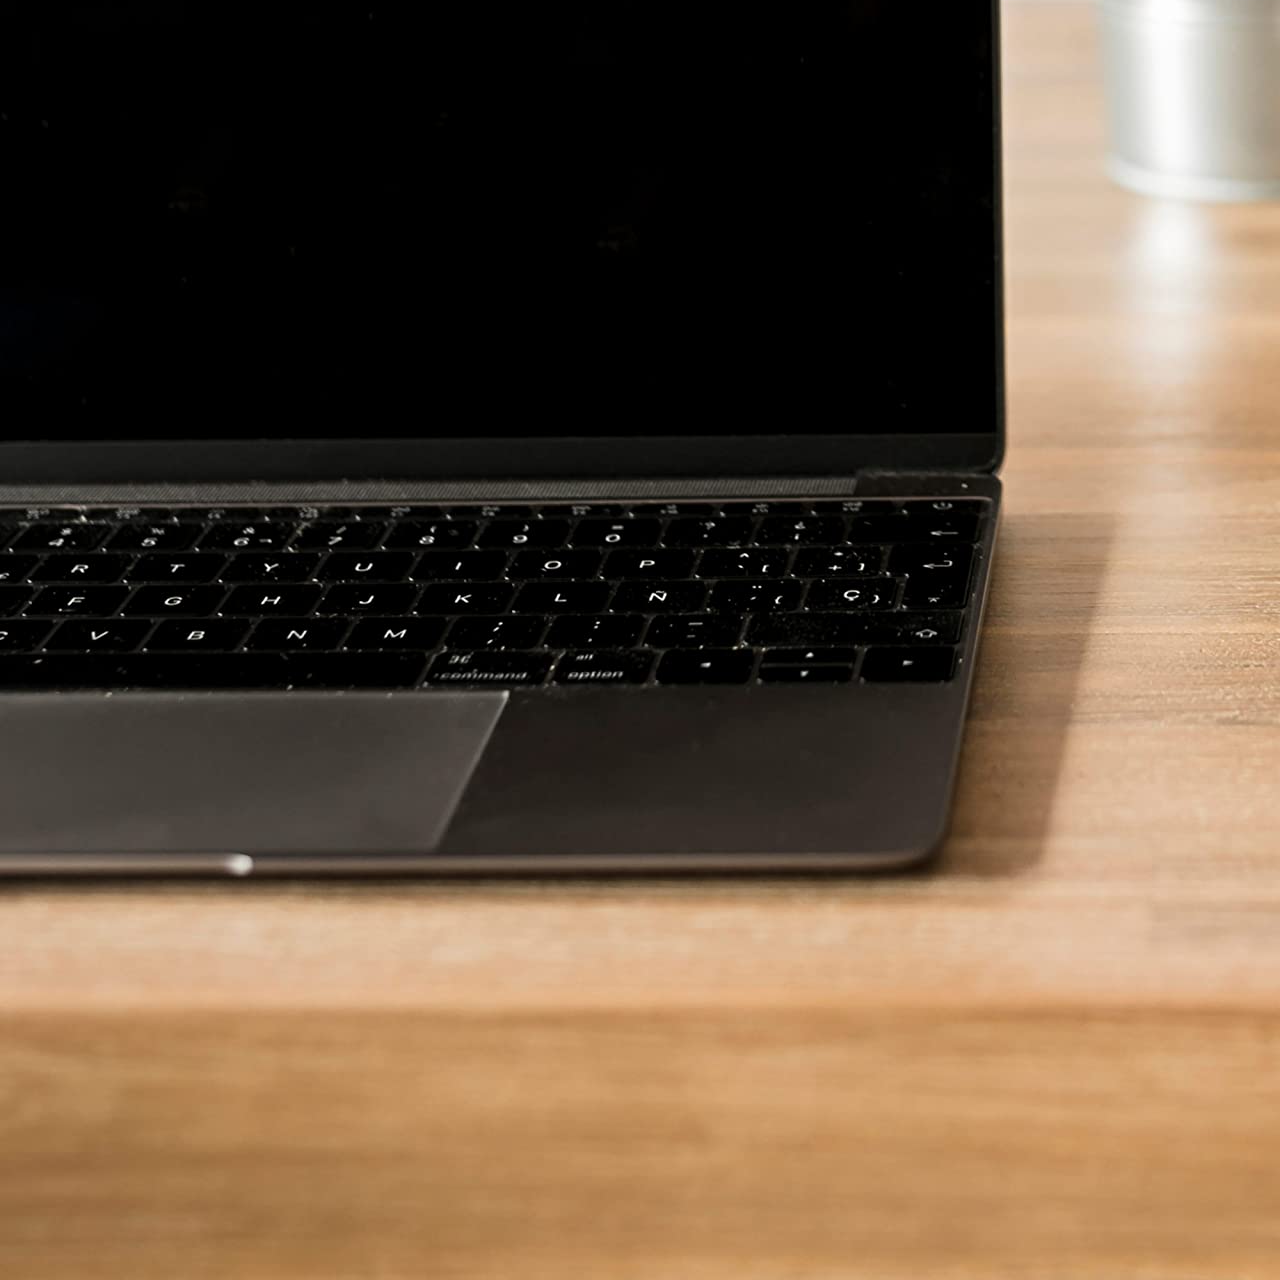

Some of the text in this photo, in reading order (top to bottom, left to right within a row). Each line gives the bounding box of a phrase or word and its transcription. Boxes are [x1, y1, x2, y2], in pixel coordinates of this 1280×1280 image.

[233, 536, 250, 547] 6
[418, 535, 435, 545] 8
[512, 534, 529, 544] 9
[70, 564, 89, 574] R
[170, 563, 186, 573] T
[263, 562, 280, 573] Y
[354, 562, 374, 572] U
[543, 560, 562, 570] O
[639, 559, 656, 569] P
[66, 596, 86, 607] F
[163, 596, 183, 606] G
[260, 595, 281, 606] H
[358, 594, 375, 605] J
[454, 594, 472, 604] K
[554, 592, 568, 603] L
[648, 590, 668, 602] Ñ
[843, 589, 861, 602] Ç
[90, 628, 408, 641] V B N M
[440, 671, 624, 680] command option
